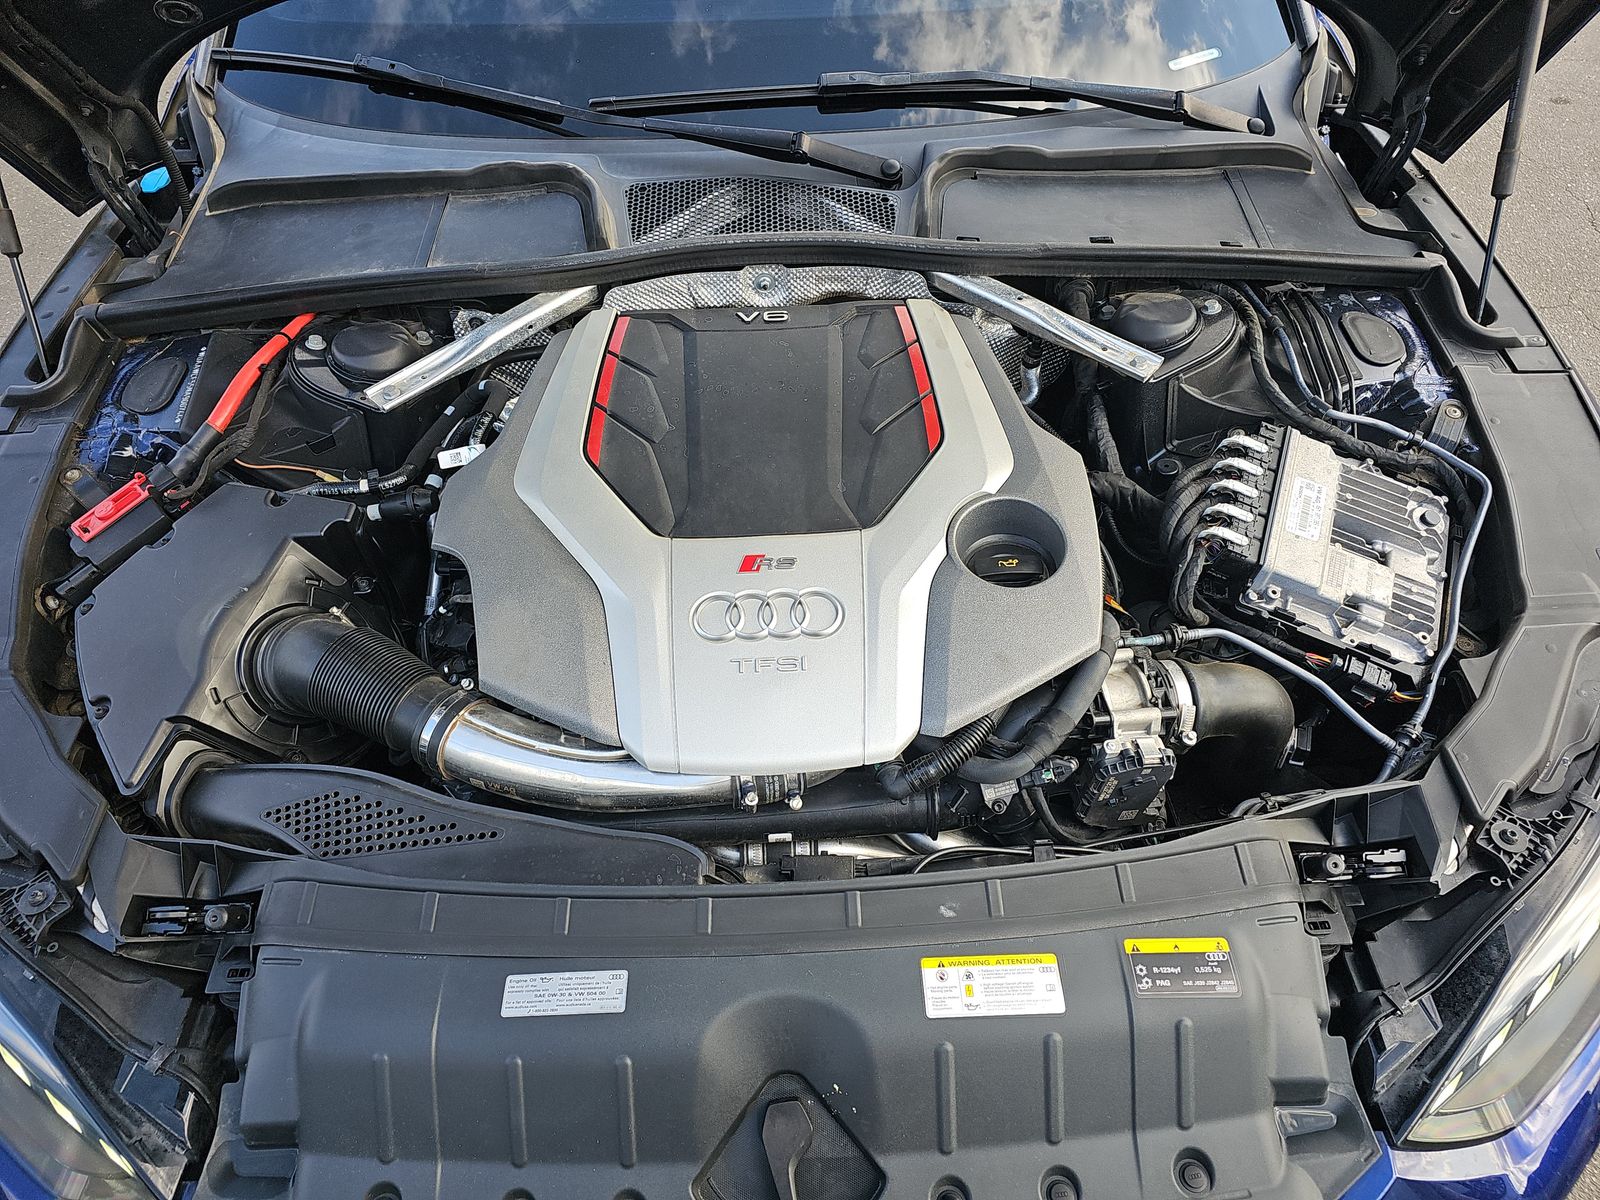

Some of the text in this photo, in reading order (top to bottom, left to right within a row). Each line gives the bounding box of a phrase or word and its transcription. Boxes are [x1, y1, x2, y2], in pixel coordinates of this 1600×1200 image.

[735, 311, 788, 324] V6
[751, 555, 798, 571] RS
[730, 656, 808, 674] TFSI
[996, 958, 1043, 966] ATTENTION
[1152, 966, 1222, 975] R-1234yf 0,525 kg
